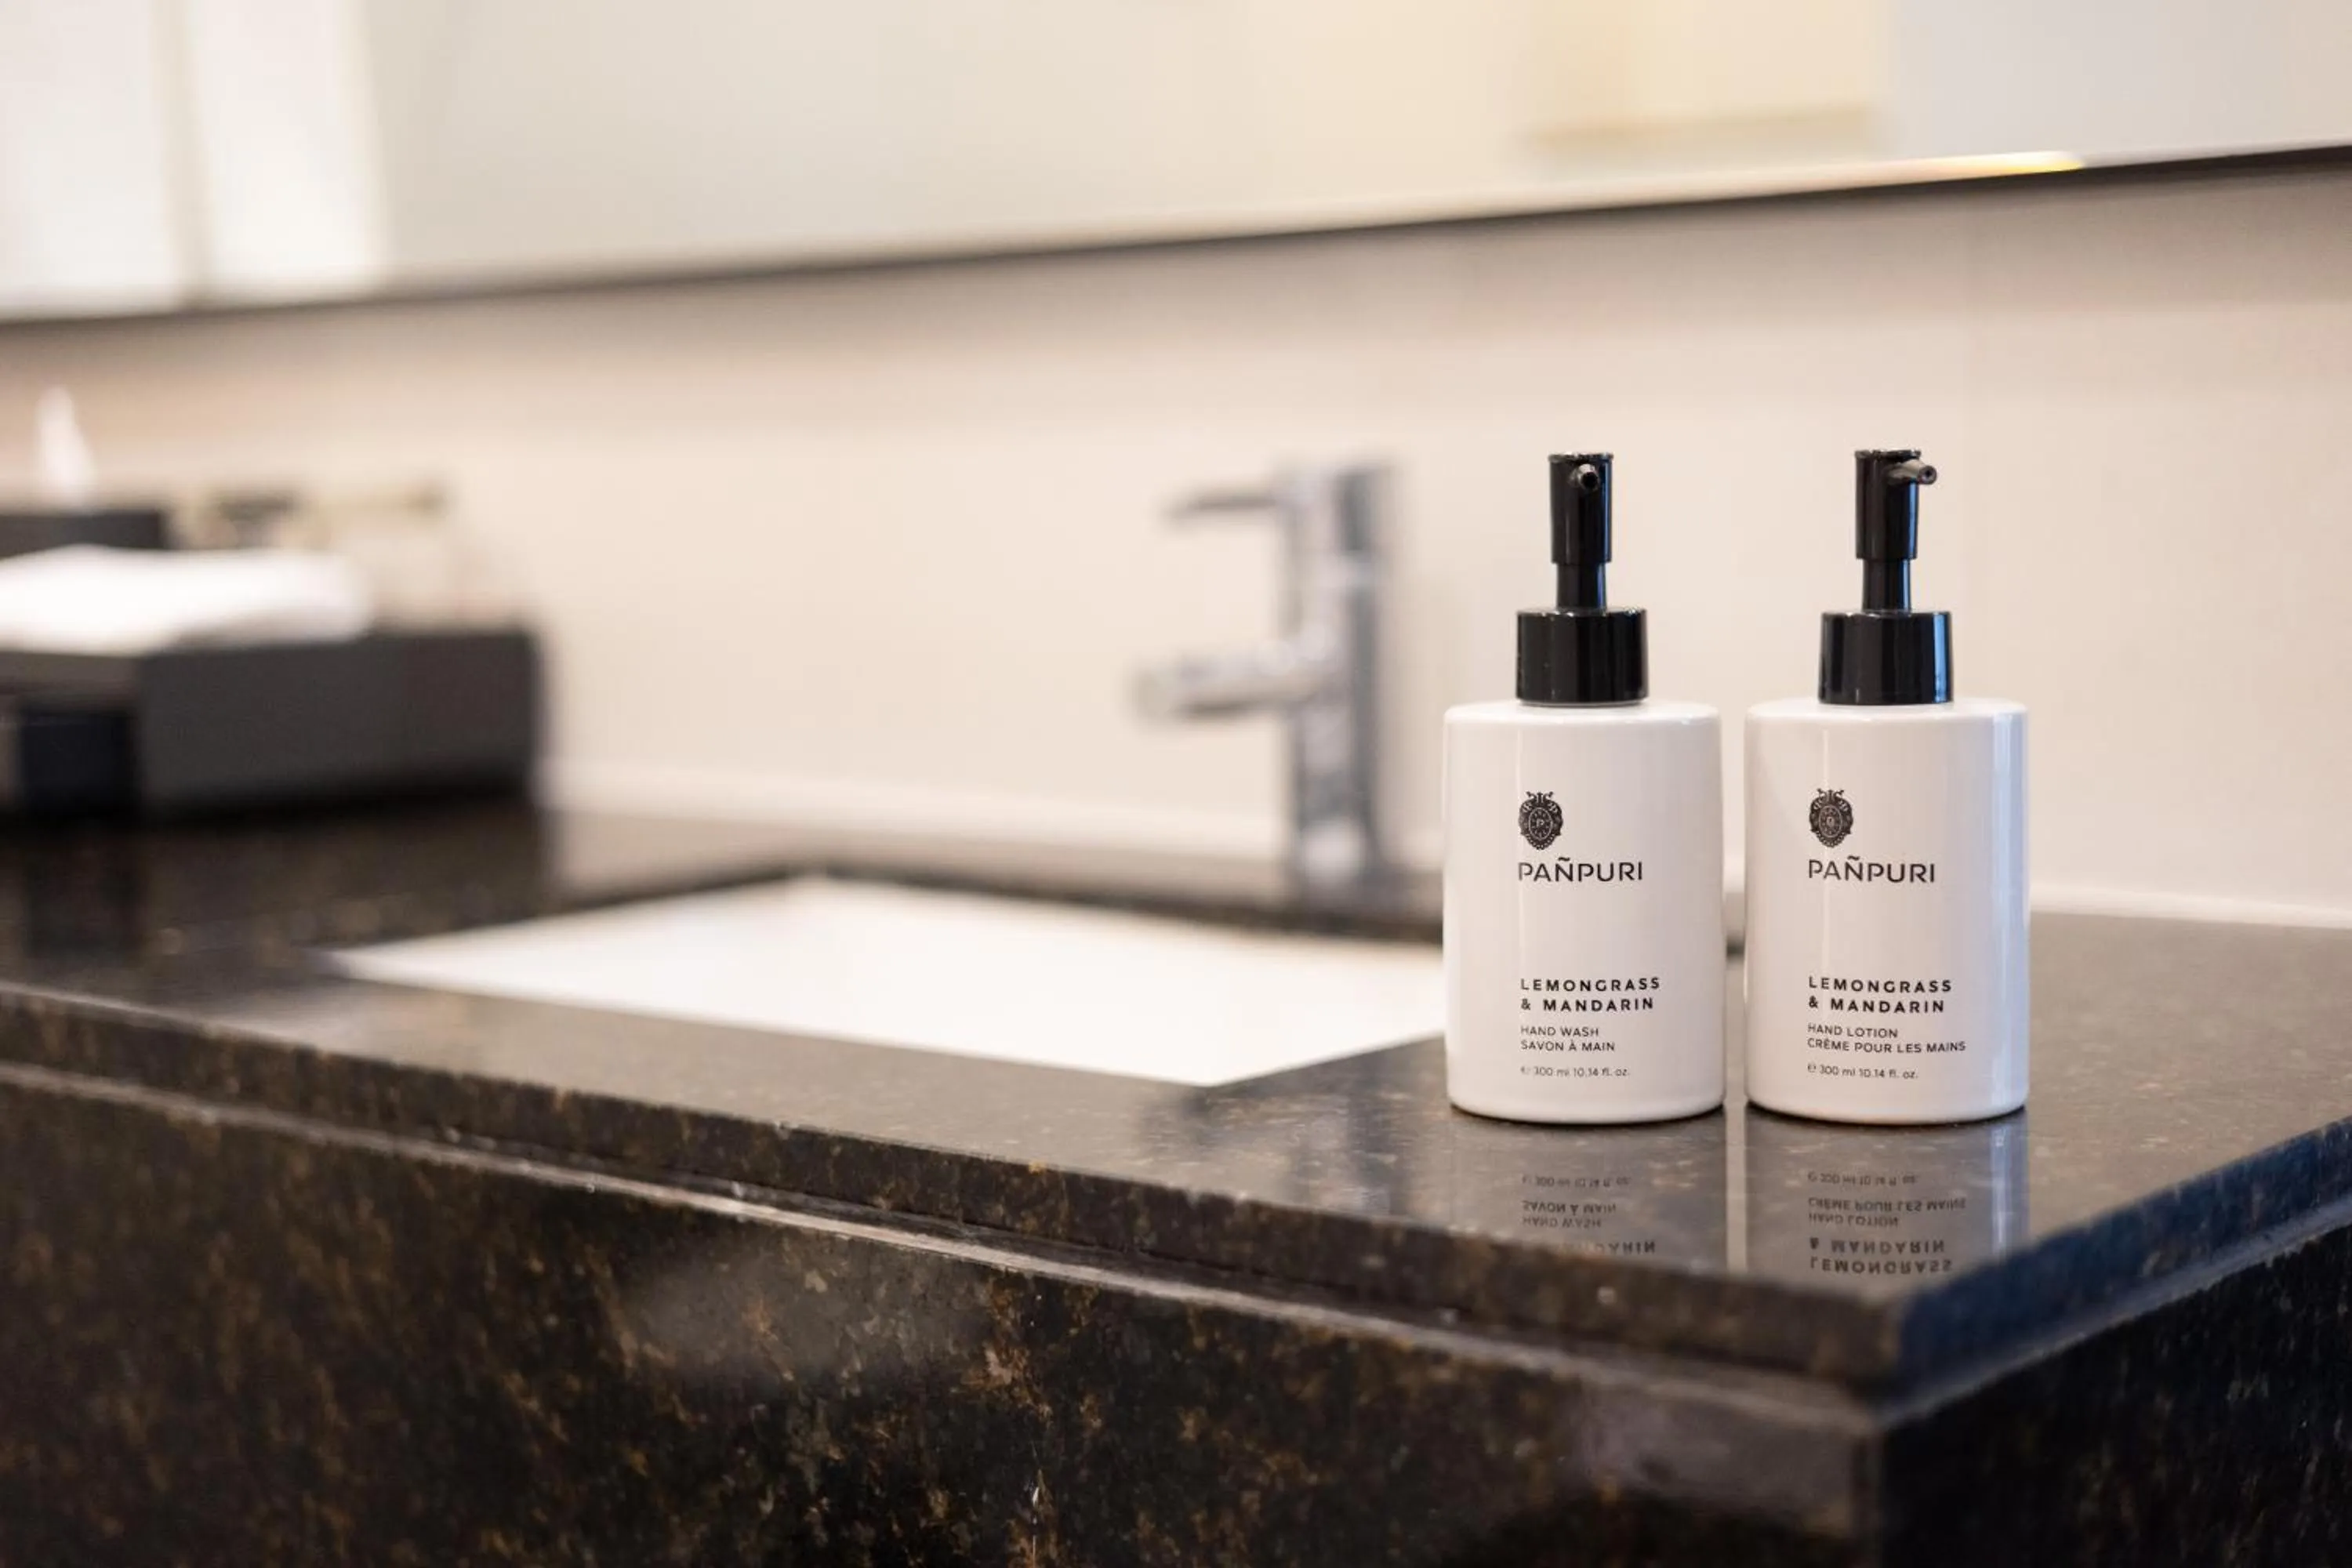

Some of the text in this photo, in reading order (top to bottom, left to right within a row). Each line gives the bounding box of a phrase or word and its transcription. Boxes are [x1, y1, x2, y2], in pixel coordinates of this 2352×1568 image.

[1518, 856, 1643, 882] PAÑPURI
[1808, 855, 1936, 883] PAÑPURI
[1520, 977, 1661, 992] LEMONGRASS
[1808, 976, 1952, 993] LEMONGRASS
[1520, 997, 1653, 1011] & MANDARIN
[1808, 995, 1944, 1013] & MANDARIN
[1520, 1025, 1599, 1037] HAND WASH
[1807, 1022, 1898, 1039] HAND LOTION
[1520, 1039, 1615, 1051] SAVON À MAIN
[1854, 1043, 1893, 1054] POUR
[1896, 1043, 1922, 1054] LES
[1926, 1040, 1966, 1053] MAINS
[1819, 1064, 1839, 1076] 300
[1842, 1067, 1856, 1076] ml
[1859, 1068, 1885, 1078] 10.14
